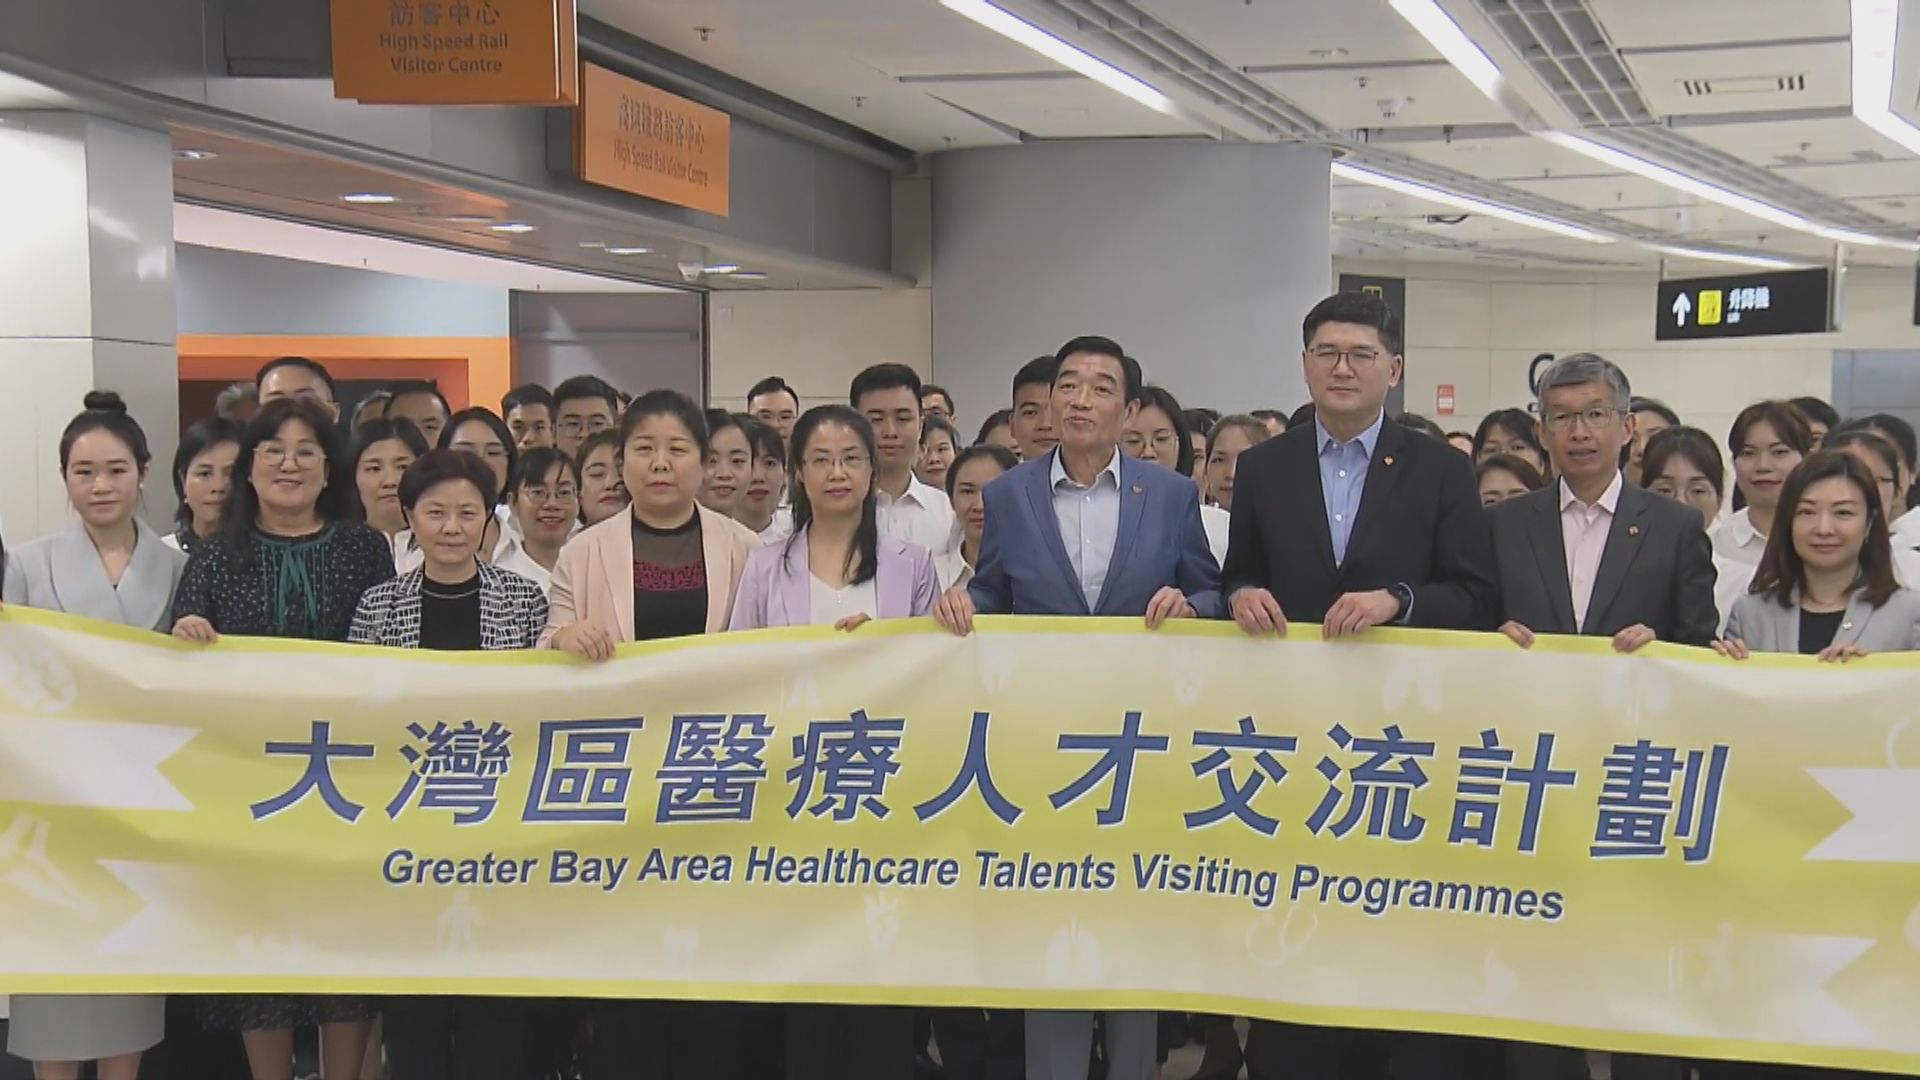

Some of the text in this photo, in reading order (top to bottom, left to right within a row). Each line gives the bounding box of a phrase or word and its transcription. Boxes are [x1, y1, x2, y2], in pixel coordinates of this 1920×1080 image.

[380, 32, 508, 52] High Speed Rail
[391, 56, 502, 72] Visitor Centre
[250, 710, 1730, 863] 大灣區醫療人才交流計劃
[383, 848, 1564, 919] Greater Bay Area Healthcare Talents Visiting Programmes
